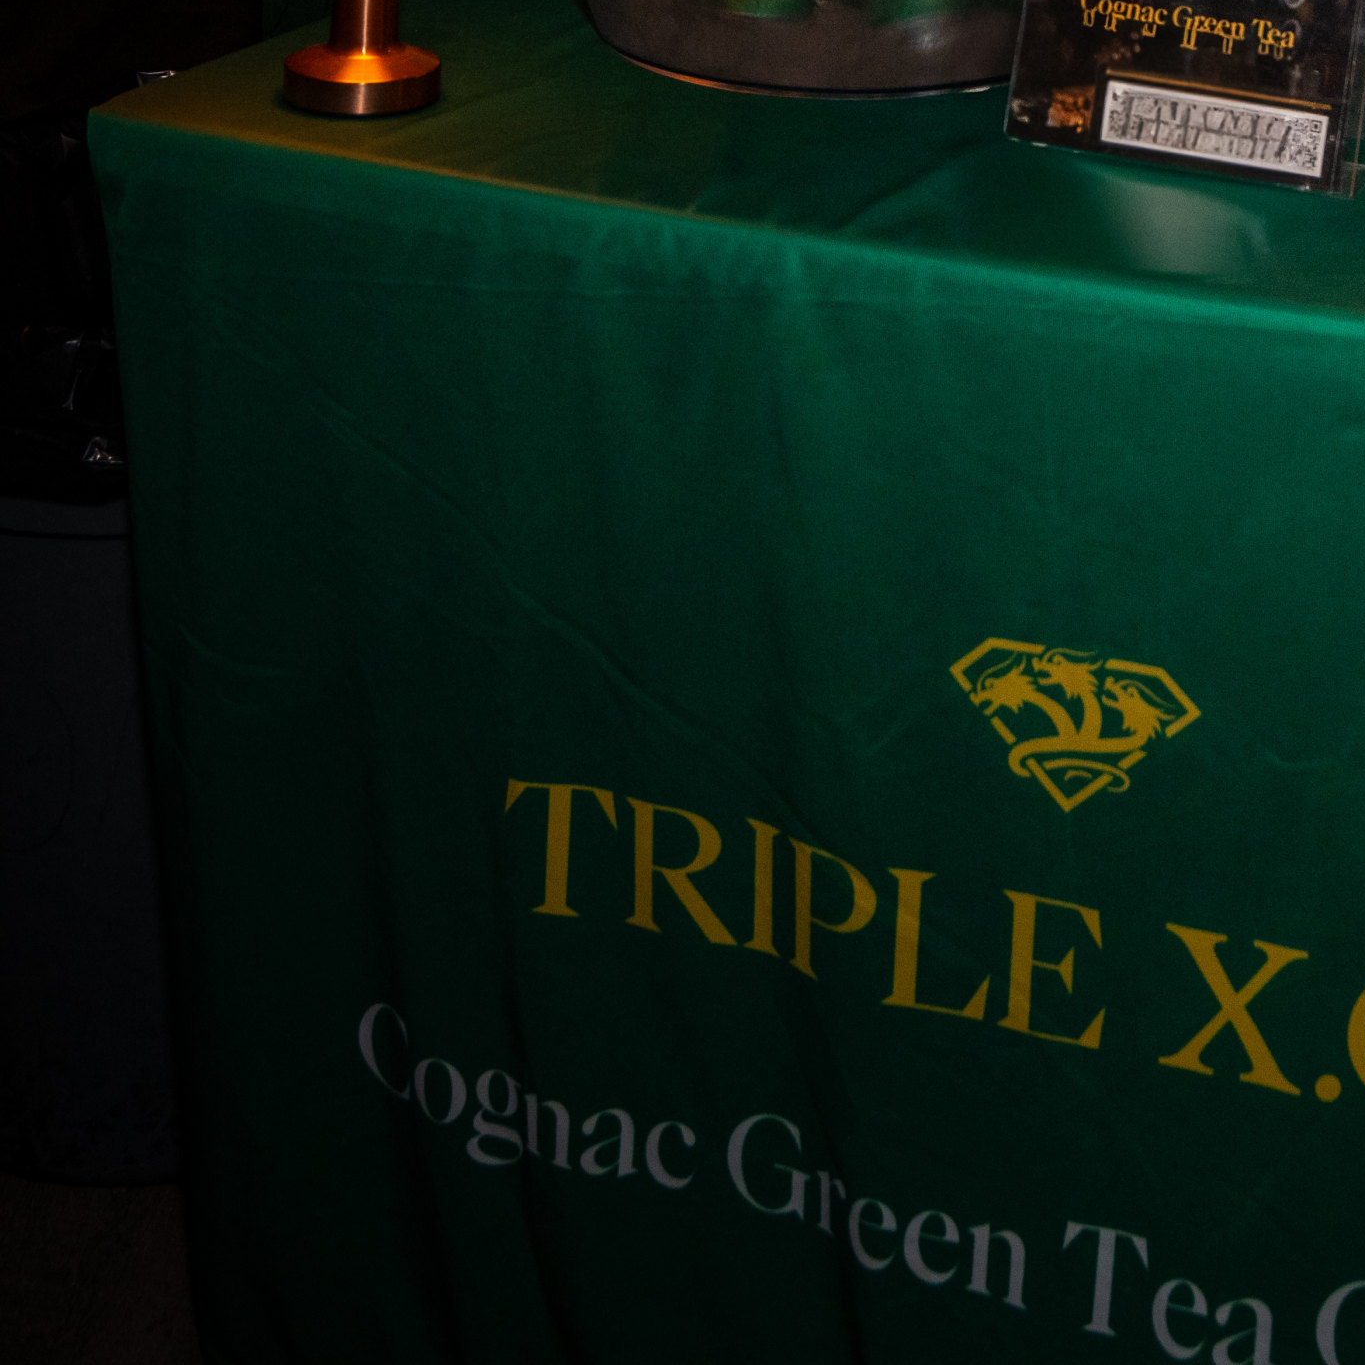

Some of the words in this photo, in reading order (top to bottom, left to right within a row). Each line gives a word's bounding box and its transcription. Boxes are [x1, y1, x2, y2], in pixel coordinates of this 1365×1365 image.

[1172, 5, 1245, 46] Green
[1251, 18, 1295, 53] Tea
[504, 777, 1107, 1050] TRIPLE
[357, 1002, 697, 1189] Cognac
[726, 1112, 1028, 1310] Green
[1061, 1220, 1274, 1365] Tea
